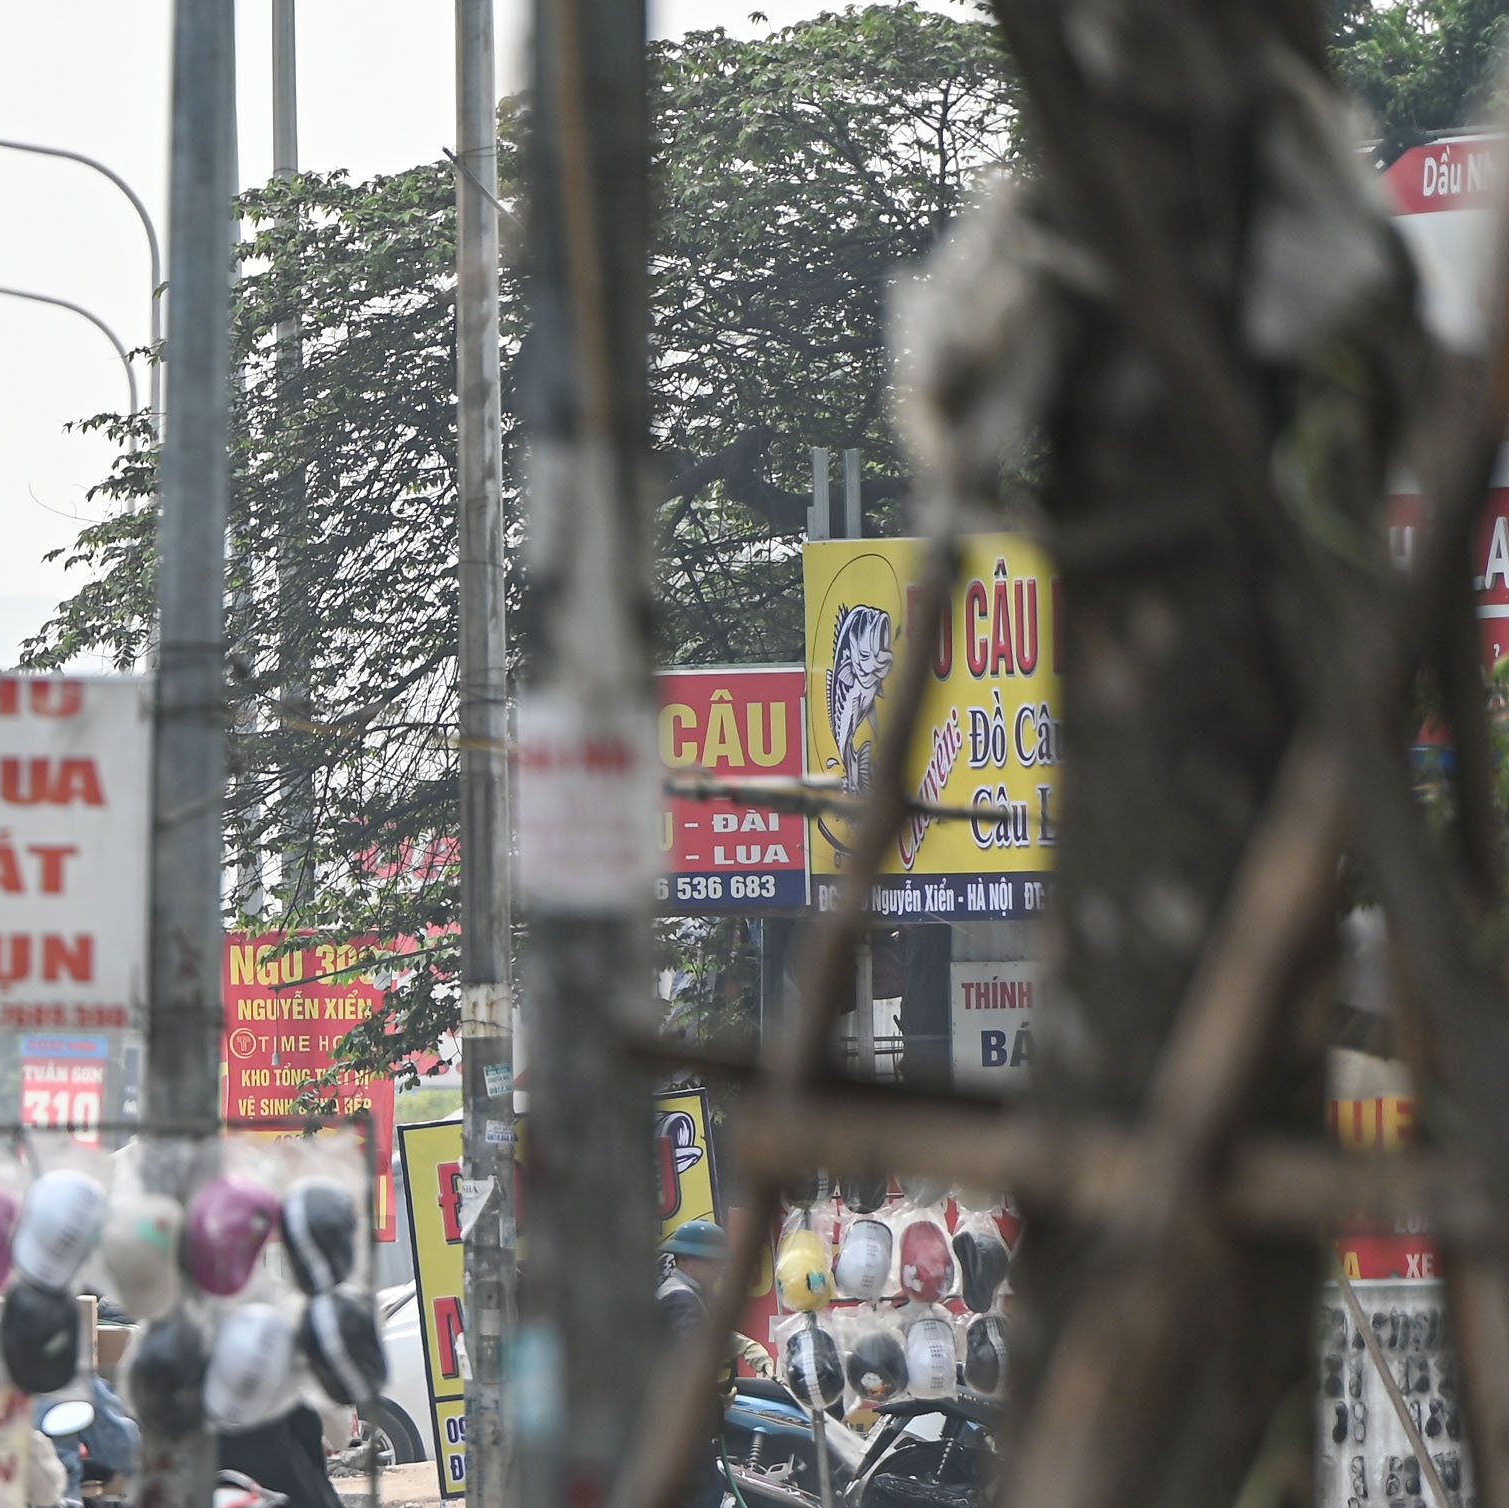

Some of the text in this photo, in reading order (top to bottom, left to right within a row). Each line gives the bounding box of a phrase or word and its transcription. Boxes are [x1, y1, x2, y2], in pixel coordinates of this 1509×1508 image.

[1423, 145, 1461, 196] Dầu
[966, 559, 1038, 679] CÂU
[657, 688, 788, 769] CÂU
[968, 689, 1007, 767] Đồ
[712, 809, 780, 833] ĐÀI
[714, 844, 790, 865] LUA
[677, 877, 723, 899] 536
[730, 875, 776, 898] 683
[872, 880, 921, 916] Nguyễn
[924, 877, 955, 912] Xiển
[967, 877, 984, 911] HÀ
[989, 876, 1013, 916] NỘI
[238, 990, 372, 1020] NGUYỄN XIỂN
[961, 976, 1033, 1010] THÍNH
[258, 1035, 310, 1052] TIME
[241, 1069, 270, 1087] KHO
[274, 1062, 311, 1087] TỔNG
[238, 1096, 256, 1119] VỆ
